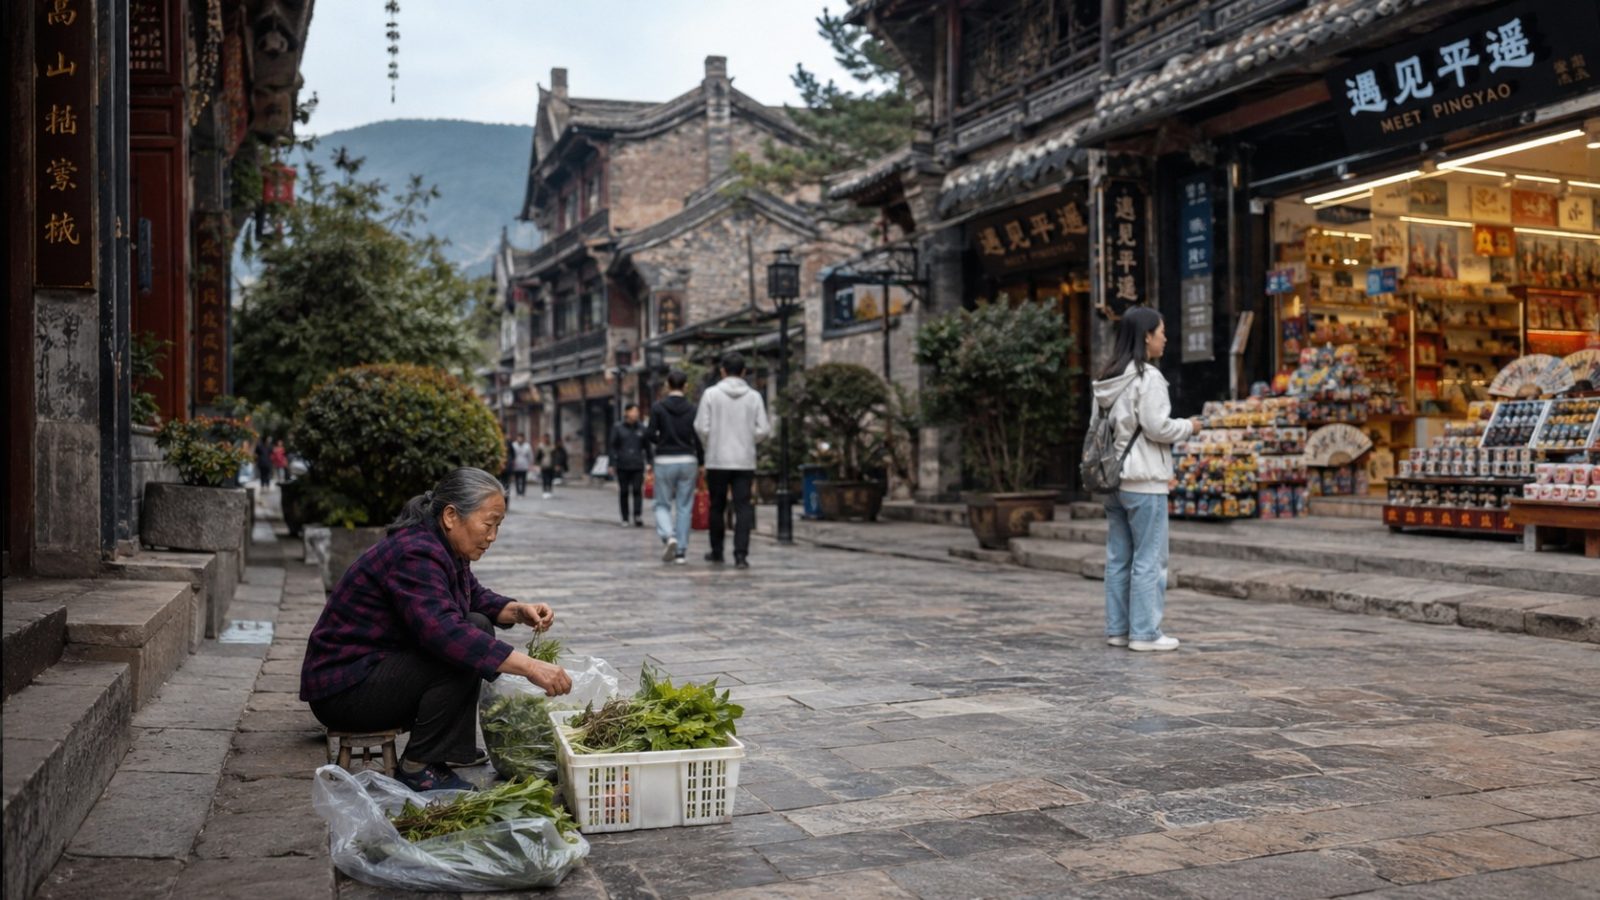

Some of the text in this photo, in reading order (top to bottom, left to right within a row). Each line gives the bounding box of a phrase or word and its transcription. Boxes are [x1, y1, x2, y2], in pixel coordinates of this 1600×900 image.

[1345, 17, 1536, 117] 遇见平遥
[1380, 83, 1512, 134] MEET PINGYAO
